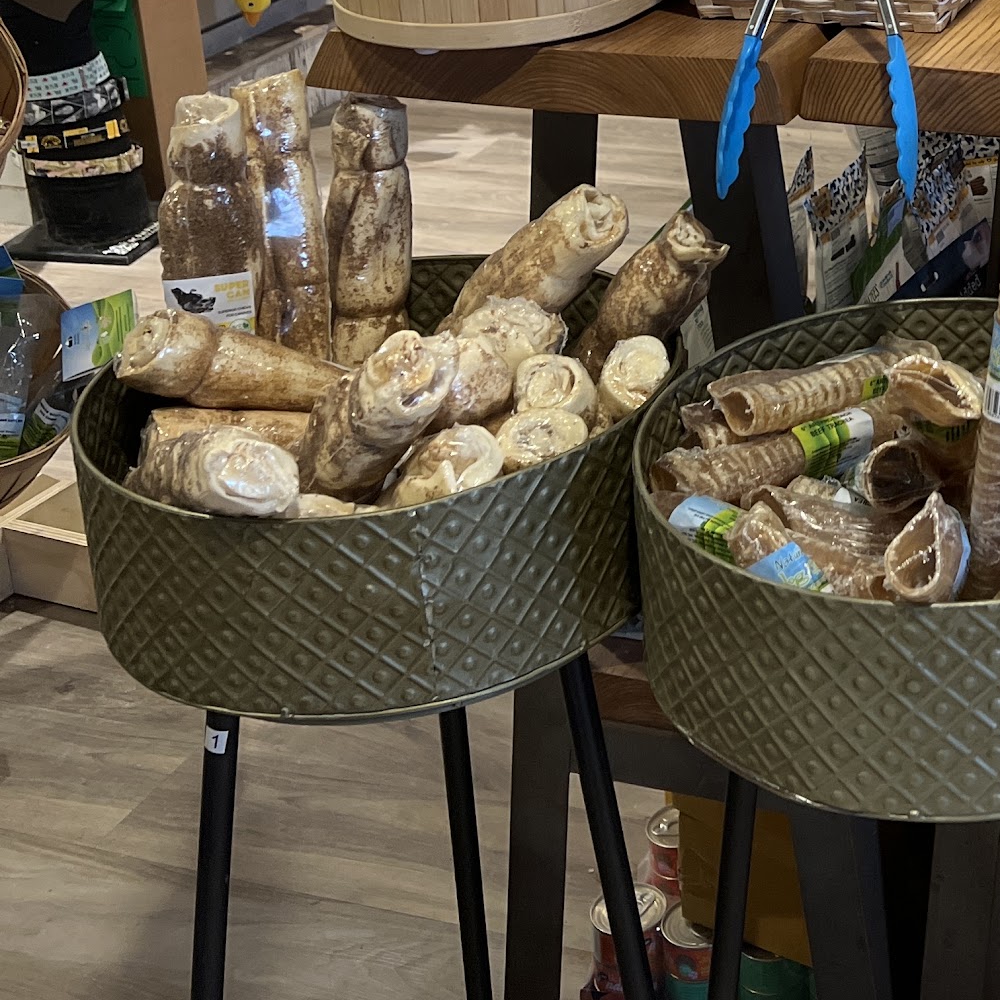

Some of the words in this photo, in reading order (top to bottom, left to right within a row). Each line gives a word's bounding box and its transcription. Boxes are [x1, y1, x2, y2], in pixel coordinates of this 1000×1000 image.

[214, 280, 248, 292] SUPER
[226, 288, 250, 298] CAN
[810, 426, 824, 438] BEEF
[212, 734, 219, 748] 1
